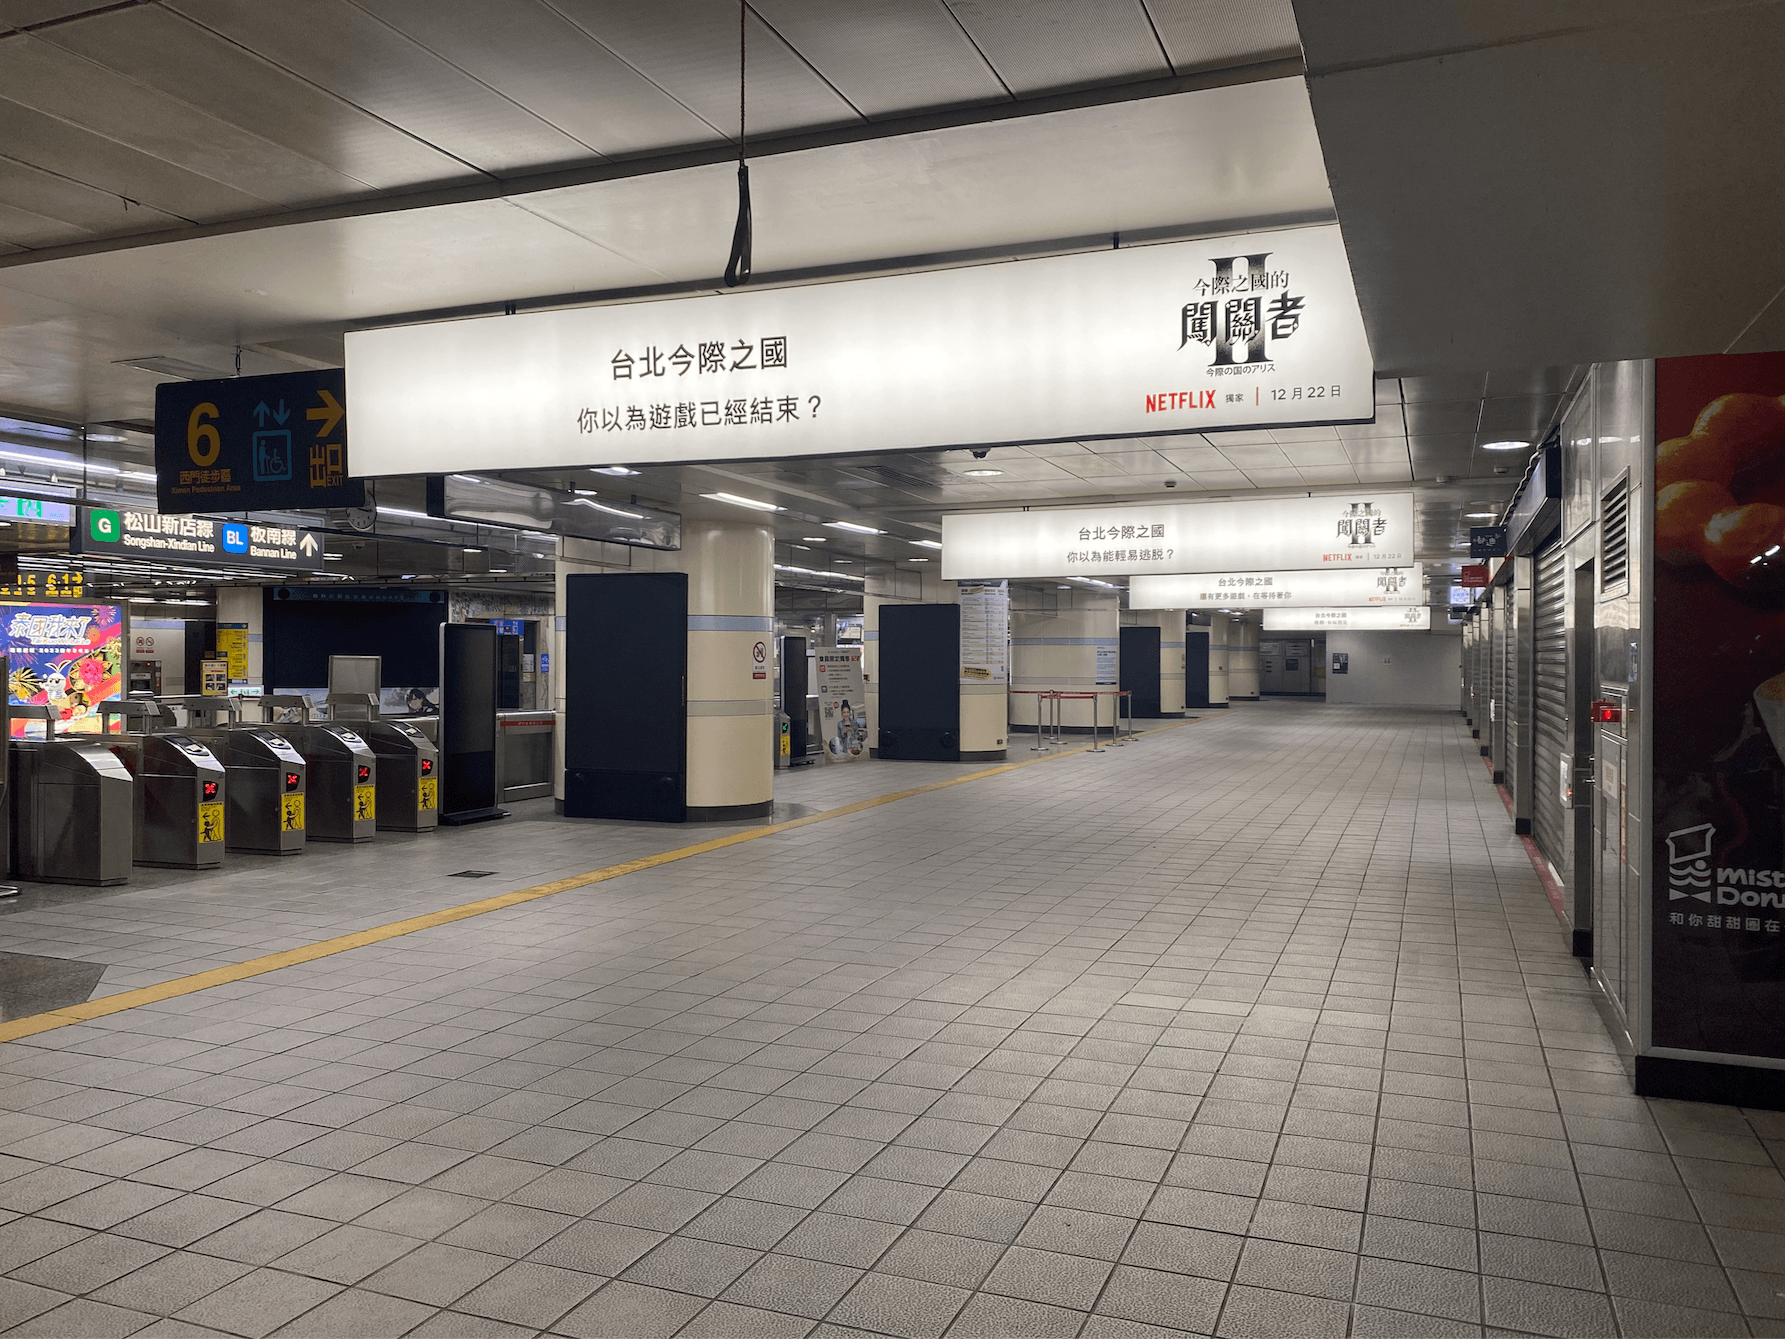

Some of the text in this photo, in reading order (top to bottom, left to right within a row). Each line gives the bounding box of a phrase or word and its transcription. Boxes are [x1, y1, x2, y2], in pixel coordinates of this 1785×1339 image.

[1193, 270, 1290, 297] 今際之國的
[1177, 289, 1306, 352] 闖關者
[610, 335, 788, 381] 台北今際之國
[1205, 363, 1276, 377] 今際の国のアリス
[1145, 389, 1217, 414] NETFLIX
[1225, 393, 1244, 403] 獨家
[577, 394, 822, 435] 你以為遊戲已經結束？
[187, 401, 221, 467] 6
[179, 468, 232, 485] 西門徒步區
[326, 474, 344, 487] EXIT
[170, 484, 242, 495] Ximen Pedestrian Area
[98, 517, 112, 534] G
[124, 511, 215, 538] 松山新店線
[1078, 523, 1165, 541] 台北今際之國
[124, 535, 215, 553] Songshan-Xindian Line
[226, 530, 244, 546] BL
[250, 526, 297, 546] 板南線
[250, 546, 297, 560] Bannan Line
[1322, 553, 1353, 562] NETFLIX
[1218, 576, 1273, 587] 台北今際之國
